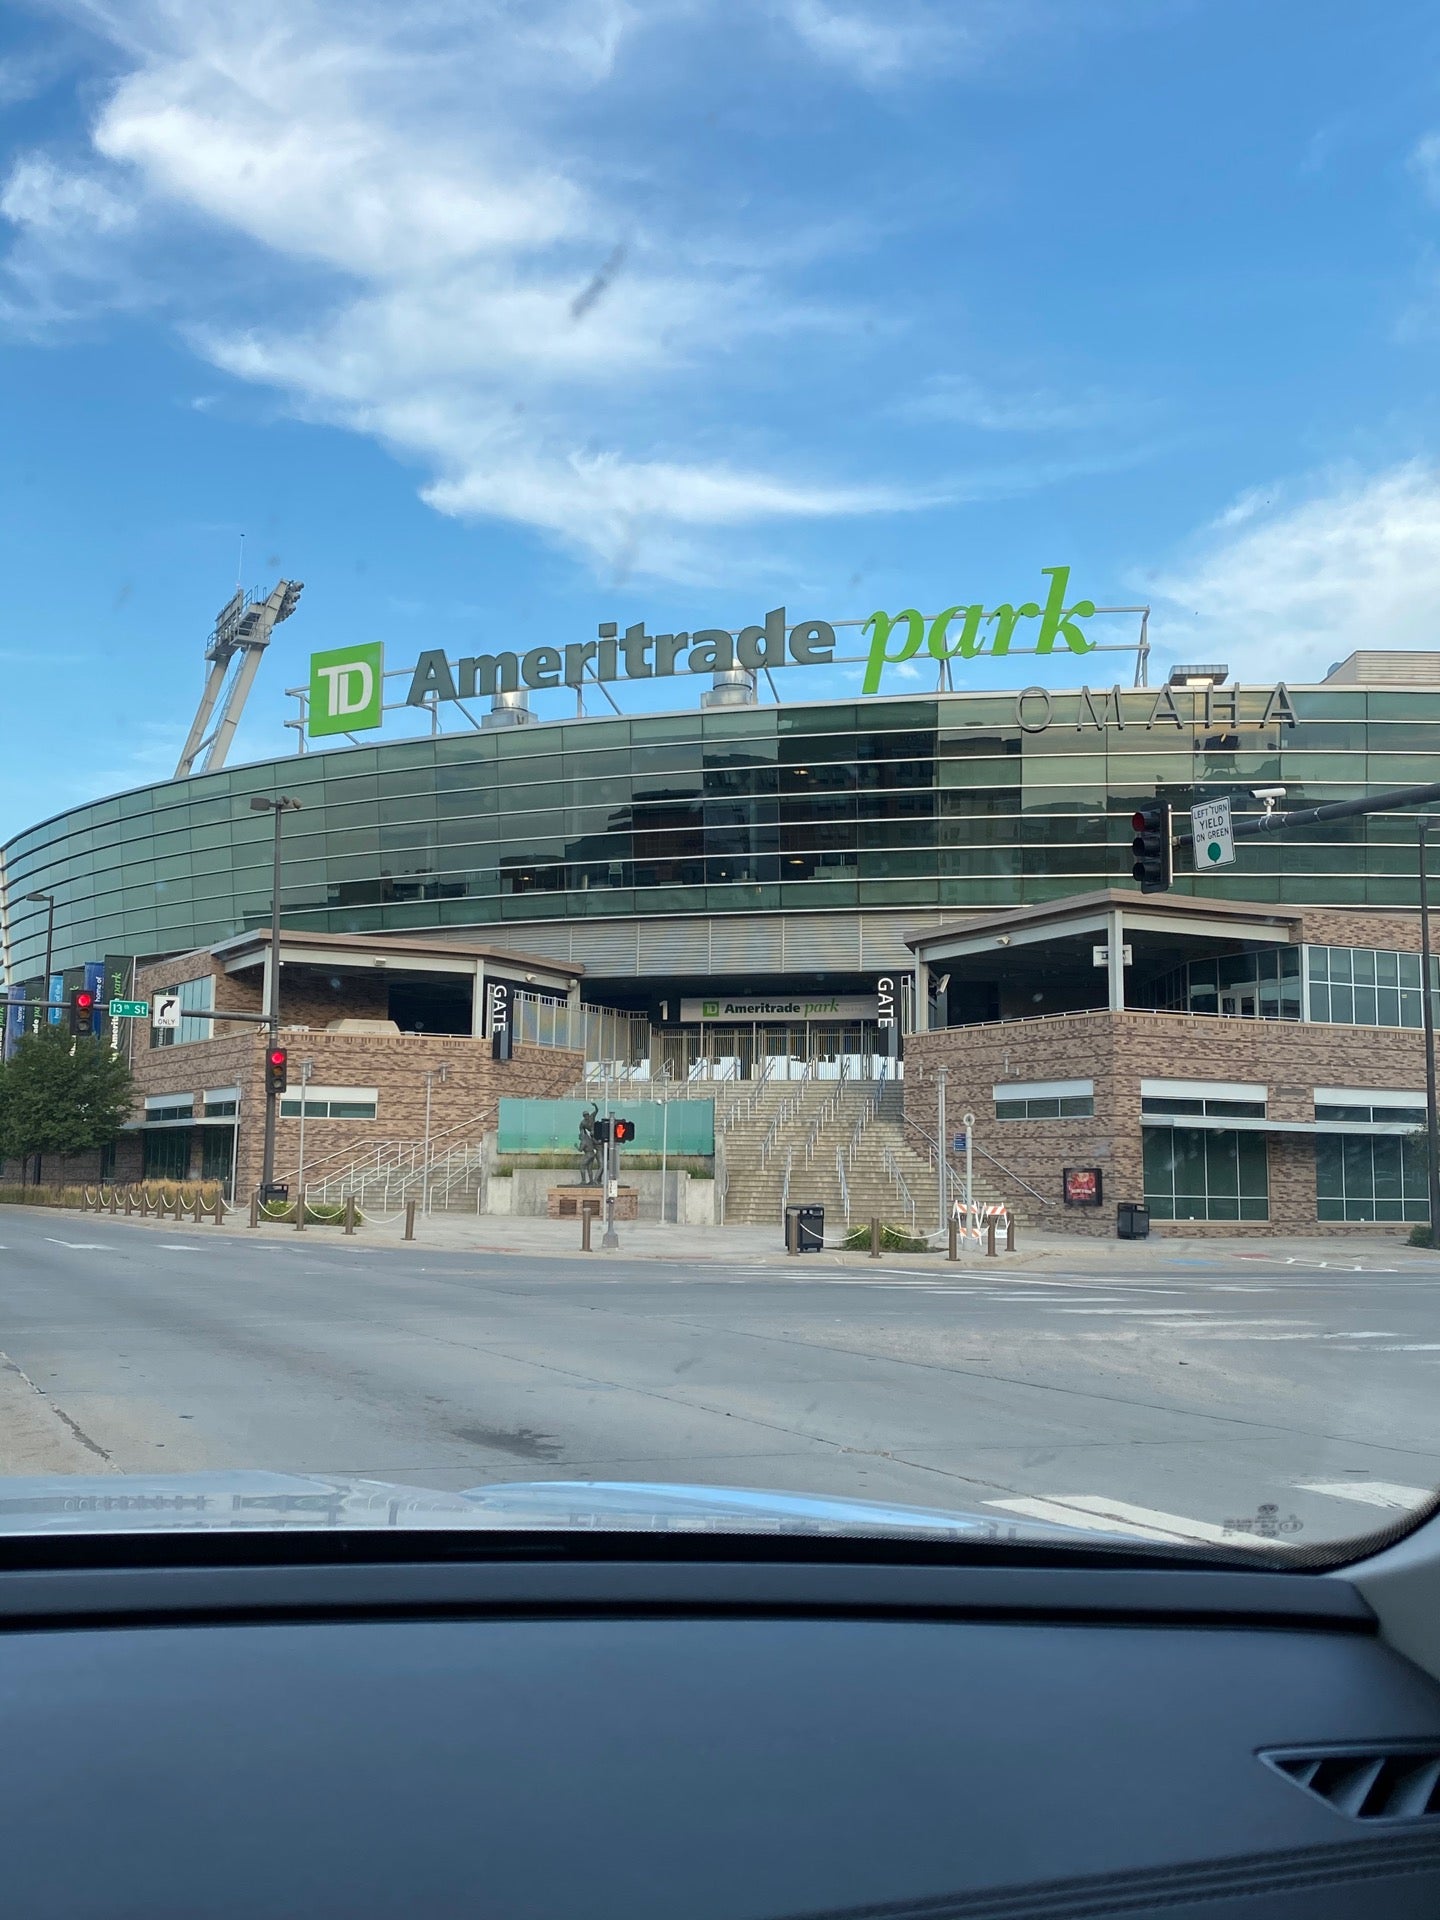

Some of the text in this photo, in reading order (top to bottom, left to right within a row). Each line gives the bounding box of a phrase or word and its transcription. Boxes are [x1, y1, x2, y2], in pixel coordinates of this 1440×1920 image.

[317, 566, 1097, 716] TD Ameritrade park
[1015, 682, 1299, 733] OMAHA
[1194, 803, 1227, 819] LEFT TURN
[1200, 815, 1223, 830] YIELD
[1196, 827, 1229, 843] ON GREEN
[112, 972, 123, 997] park
[134, 1006, 145, 1014] St
[492, 985, 507, 1032] GATE
[659, 1000, 668, 1021] 1
[724, 1002, 800, 1014] Ameritrade
[804, 998, 840, 1018] park
[878, 977, 894, 1028] GATE
